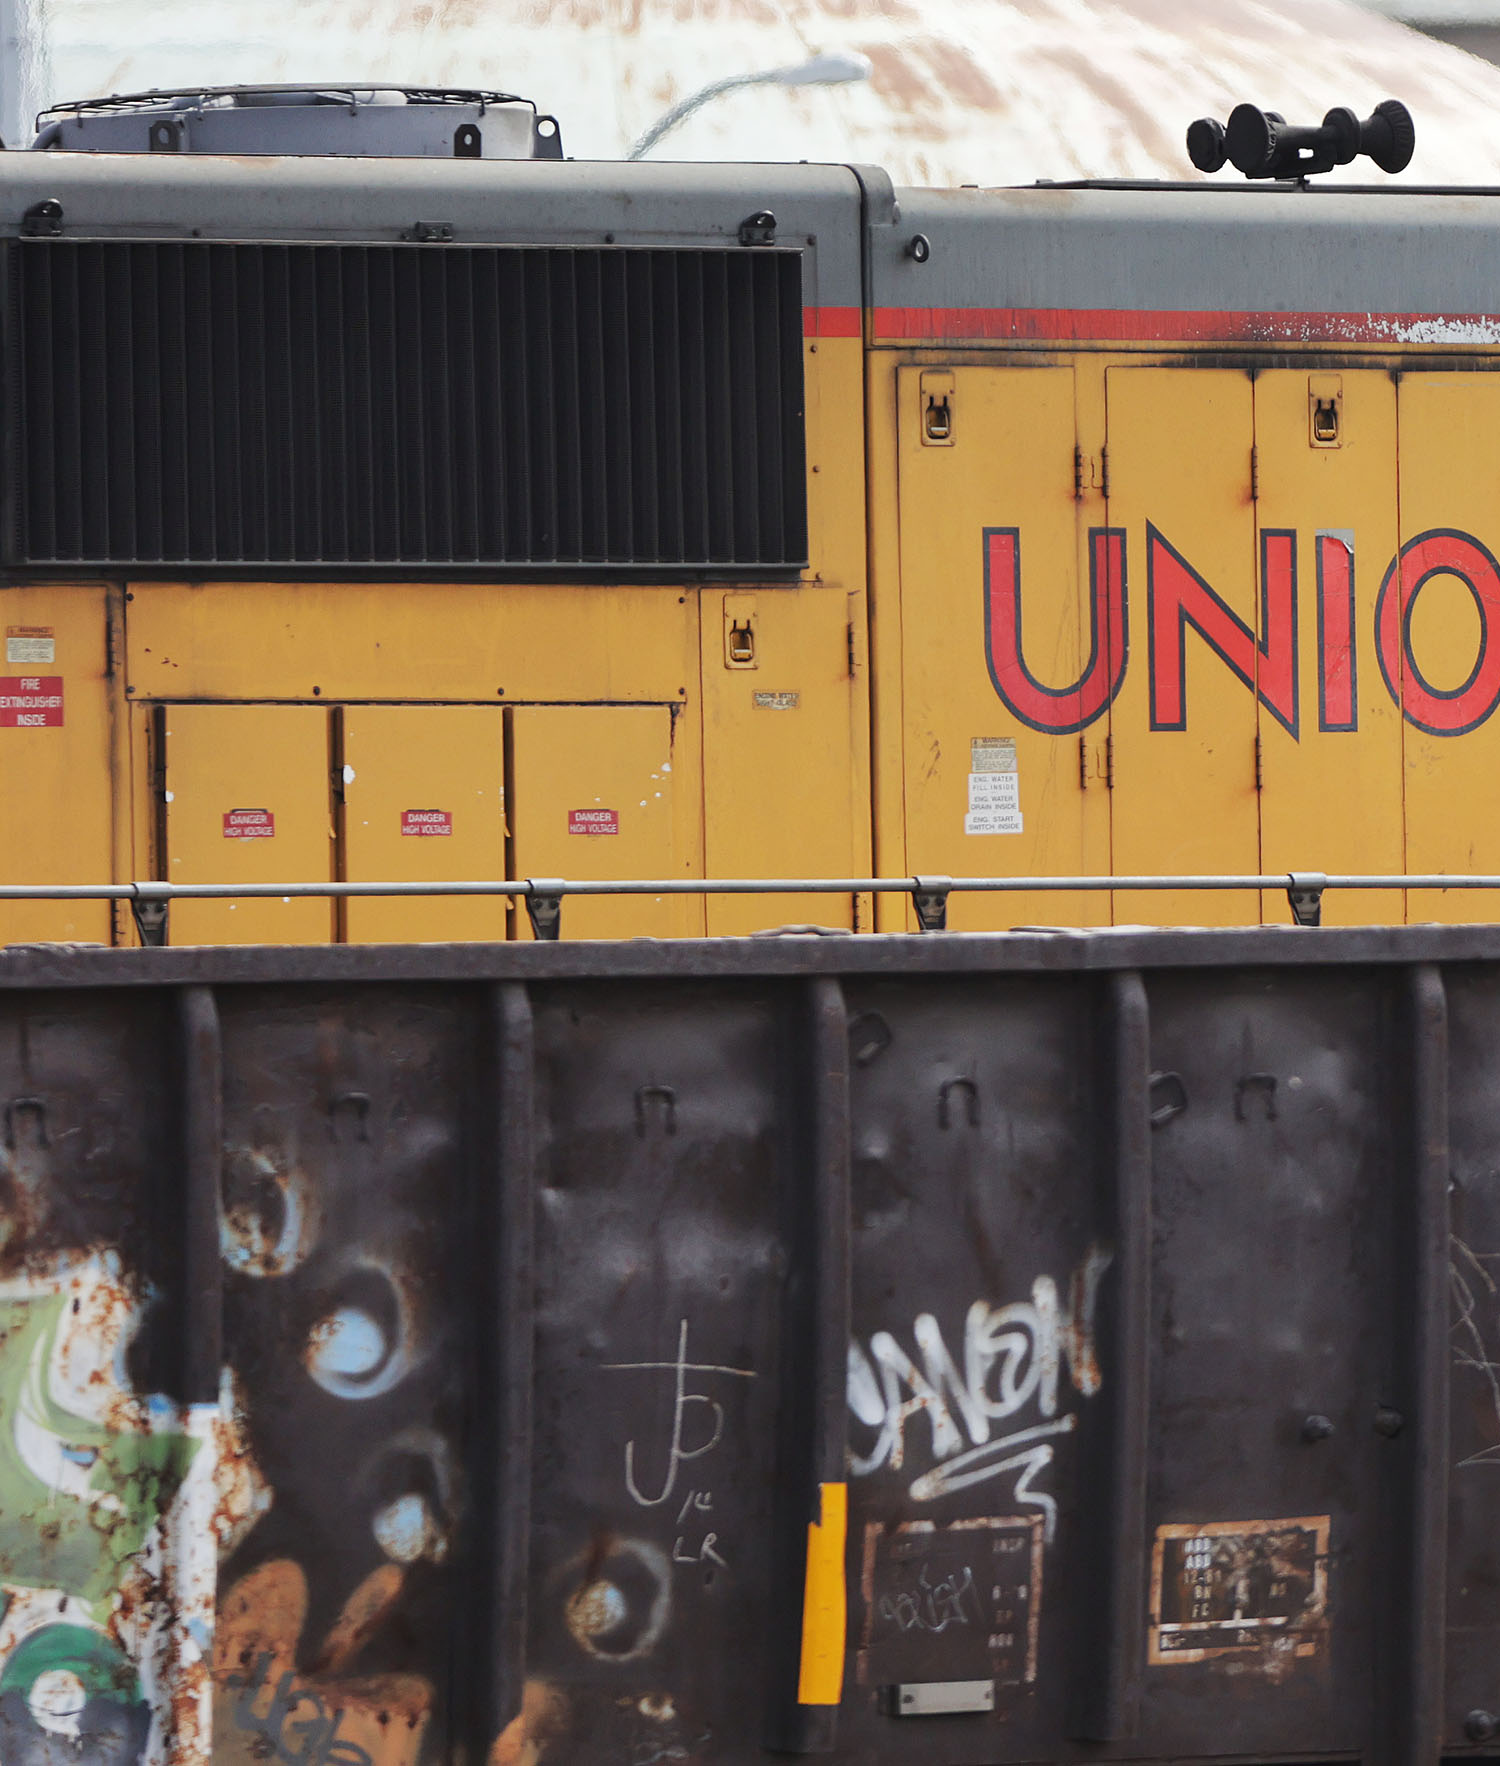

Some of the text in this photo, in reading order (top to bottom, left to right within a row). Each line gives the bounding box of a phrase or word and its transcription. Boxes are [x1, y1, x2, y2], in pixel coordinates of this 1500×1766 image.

[21, 679, 41, 690] FIRE
[17, 714, 46, 726] INSIDE
[229, 815, 267, 825] DANGER
[407, 813, 445, 823] DANGER
[575, 812, 611, 821] DANGER
[422, 825, 451, 834] VOLTAGE
[570, 824, 617, 833] HIGH VOLTAGE
